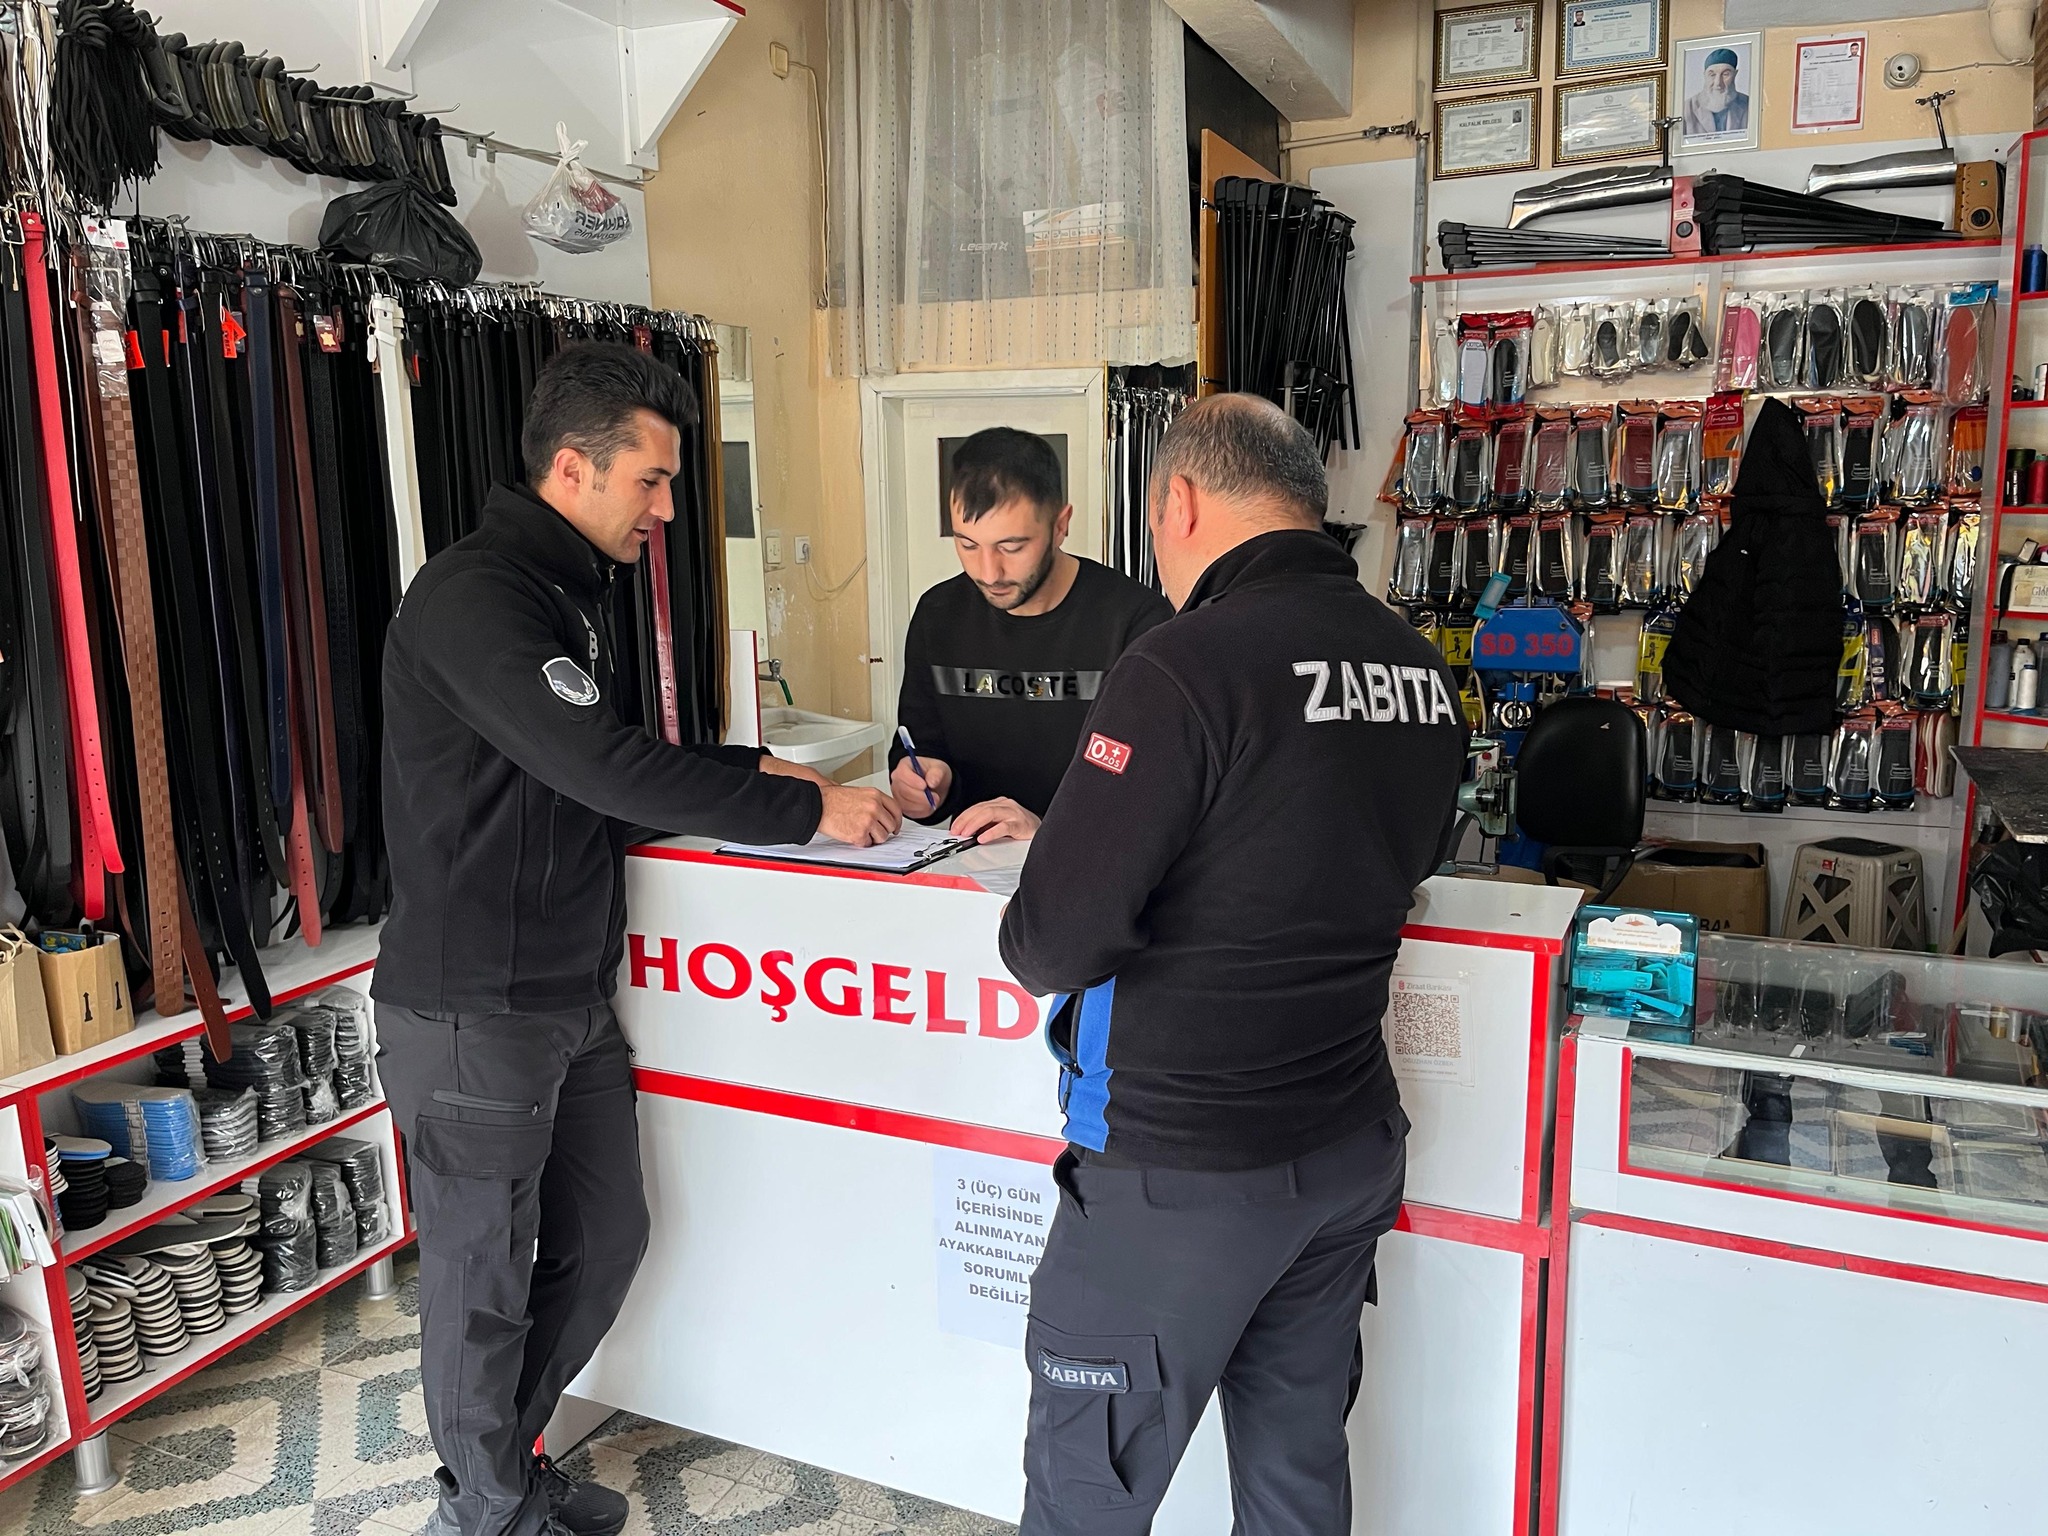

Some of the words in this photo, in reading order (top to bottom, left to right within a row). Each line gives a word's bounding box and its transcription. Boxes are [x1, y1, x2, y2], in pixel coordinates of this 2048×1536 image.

[1480, 633, 1517, 657] SD
[1524, 633, 1575, 658] 350
[963, 672, 1078, 699] LACOSTE
[1291, 660, 1458, 726] ZABITA
[1103, 754, 1120, 768] POS
[1406, 982, 1426, 991] Ziraat
[957, 1178, 966, 1190] 3
[971, 1179, 1002, 1200] (ÜÇ)
[1007, 1187, 1041, 1204] GÜN
[956, 1196, 1044, 1226] İÇERİSİNDE
[954, 1220, 1045, 1248] ALINMAYAN
[963, 1261, 1031, 1285] SORUML
[969, 1283, 1030, 1306] DEĞİLİZ
[1043, 1360, 1119, 1386] ZABITA
